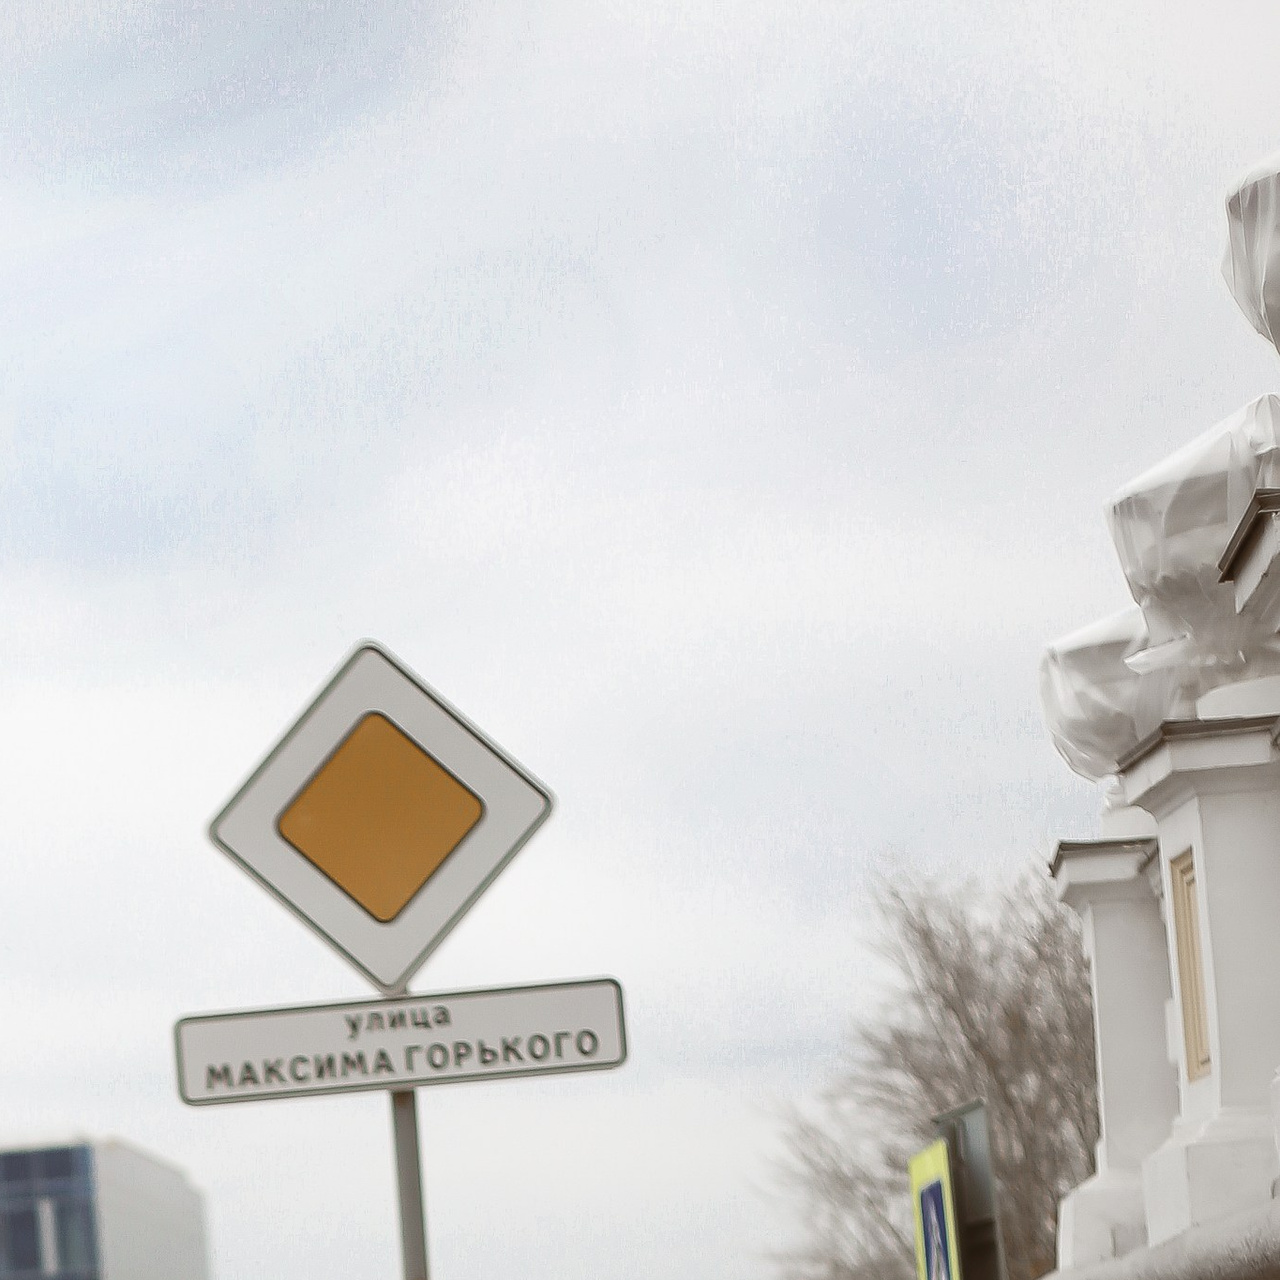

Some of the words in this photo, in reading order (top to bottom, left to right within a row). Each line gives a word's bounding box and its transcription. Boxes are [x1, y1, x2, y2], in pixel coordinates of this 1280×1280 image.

[344, 1003, 452, 1039] улица
[205, 1046, 395, 1089] МАКСИМА
[405, 1027, 599, 1070] ГОРЬКОГО
